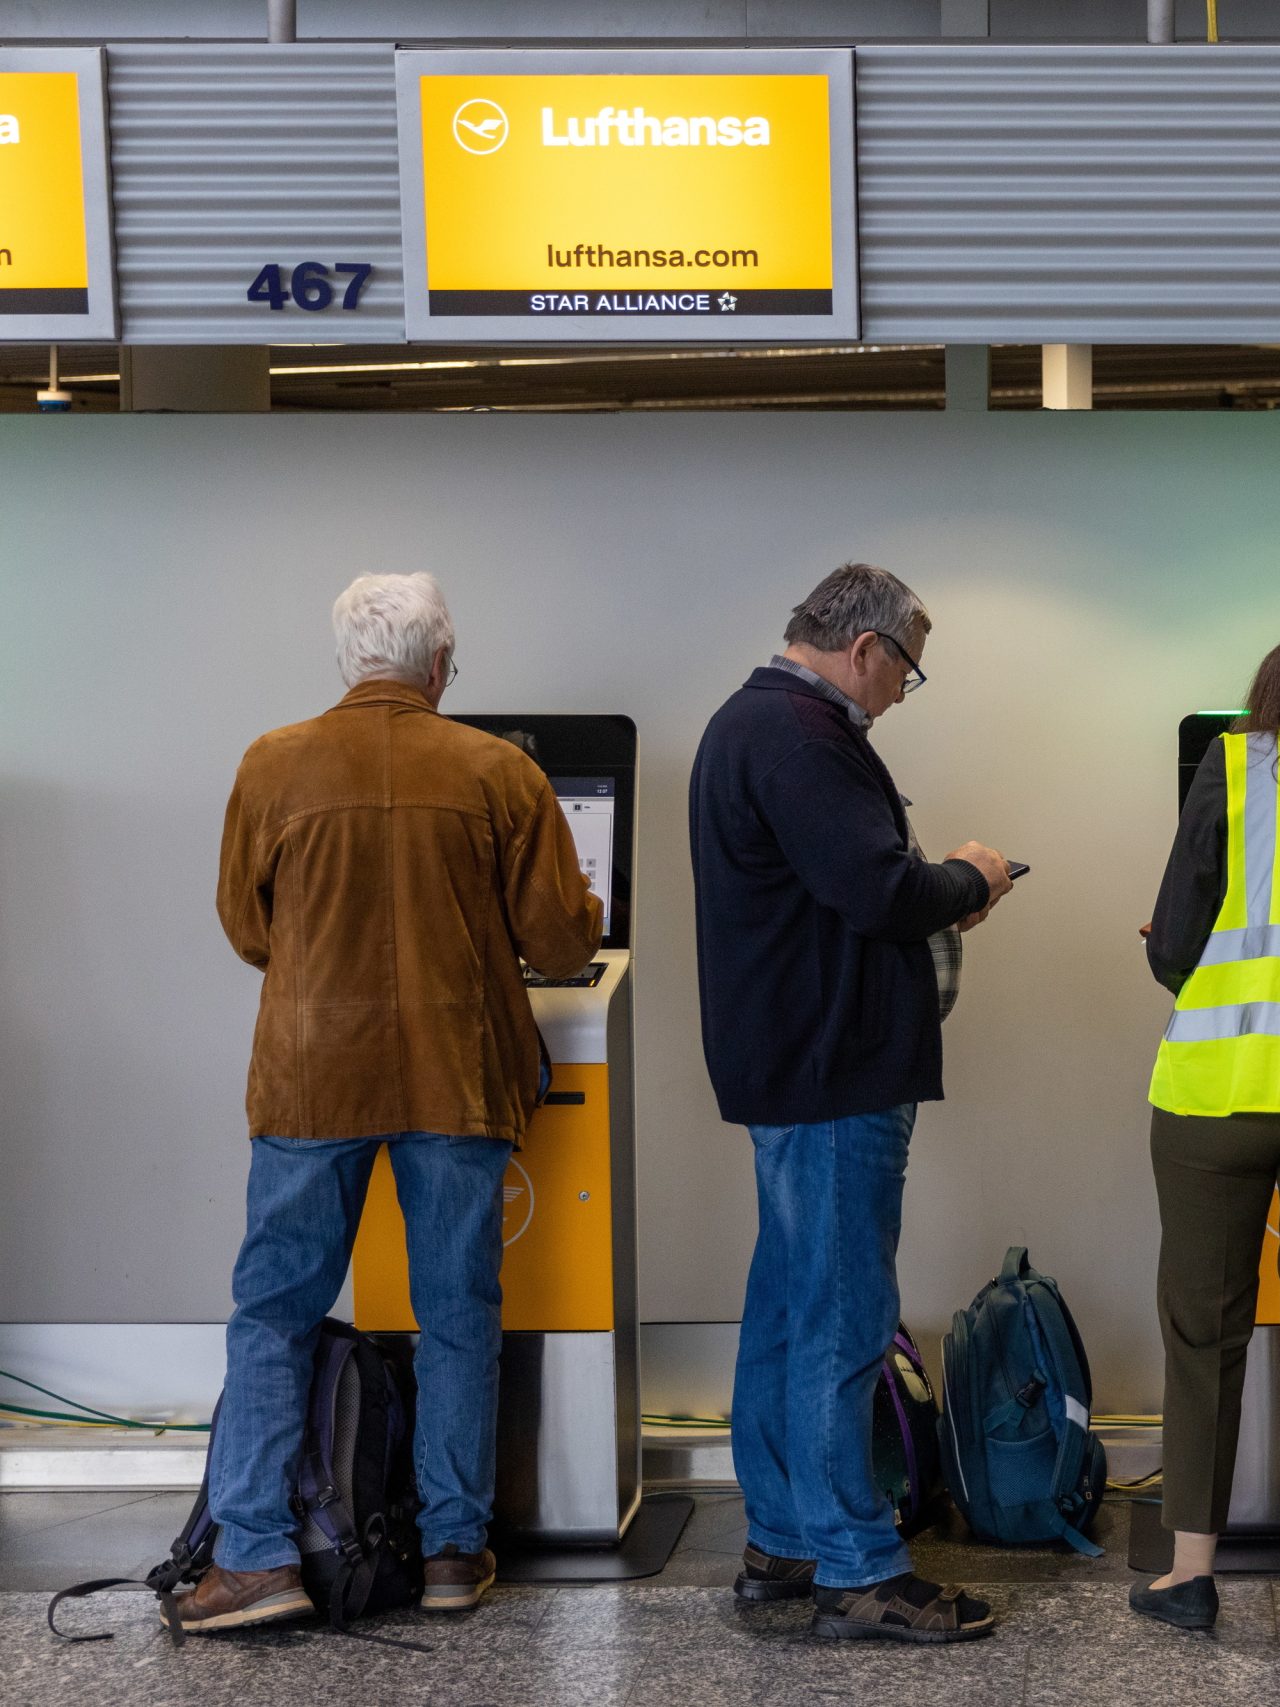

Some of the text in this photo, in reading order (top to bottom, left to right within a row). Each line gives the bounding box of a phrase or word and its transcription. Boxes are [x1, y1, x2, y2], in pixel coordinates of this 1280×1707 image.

[541, 107, 770, 147] Lufthansa
[547, 244, 759, 268] lufthansa.com
[247, 262, 373, 311] 467
[530, 294, 711, 311] STAR ALLIANCE
